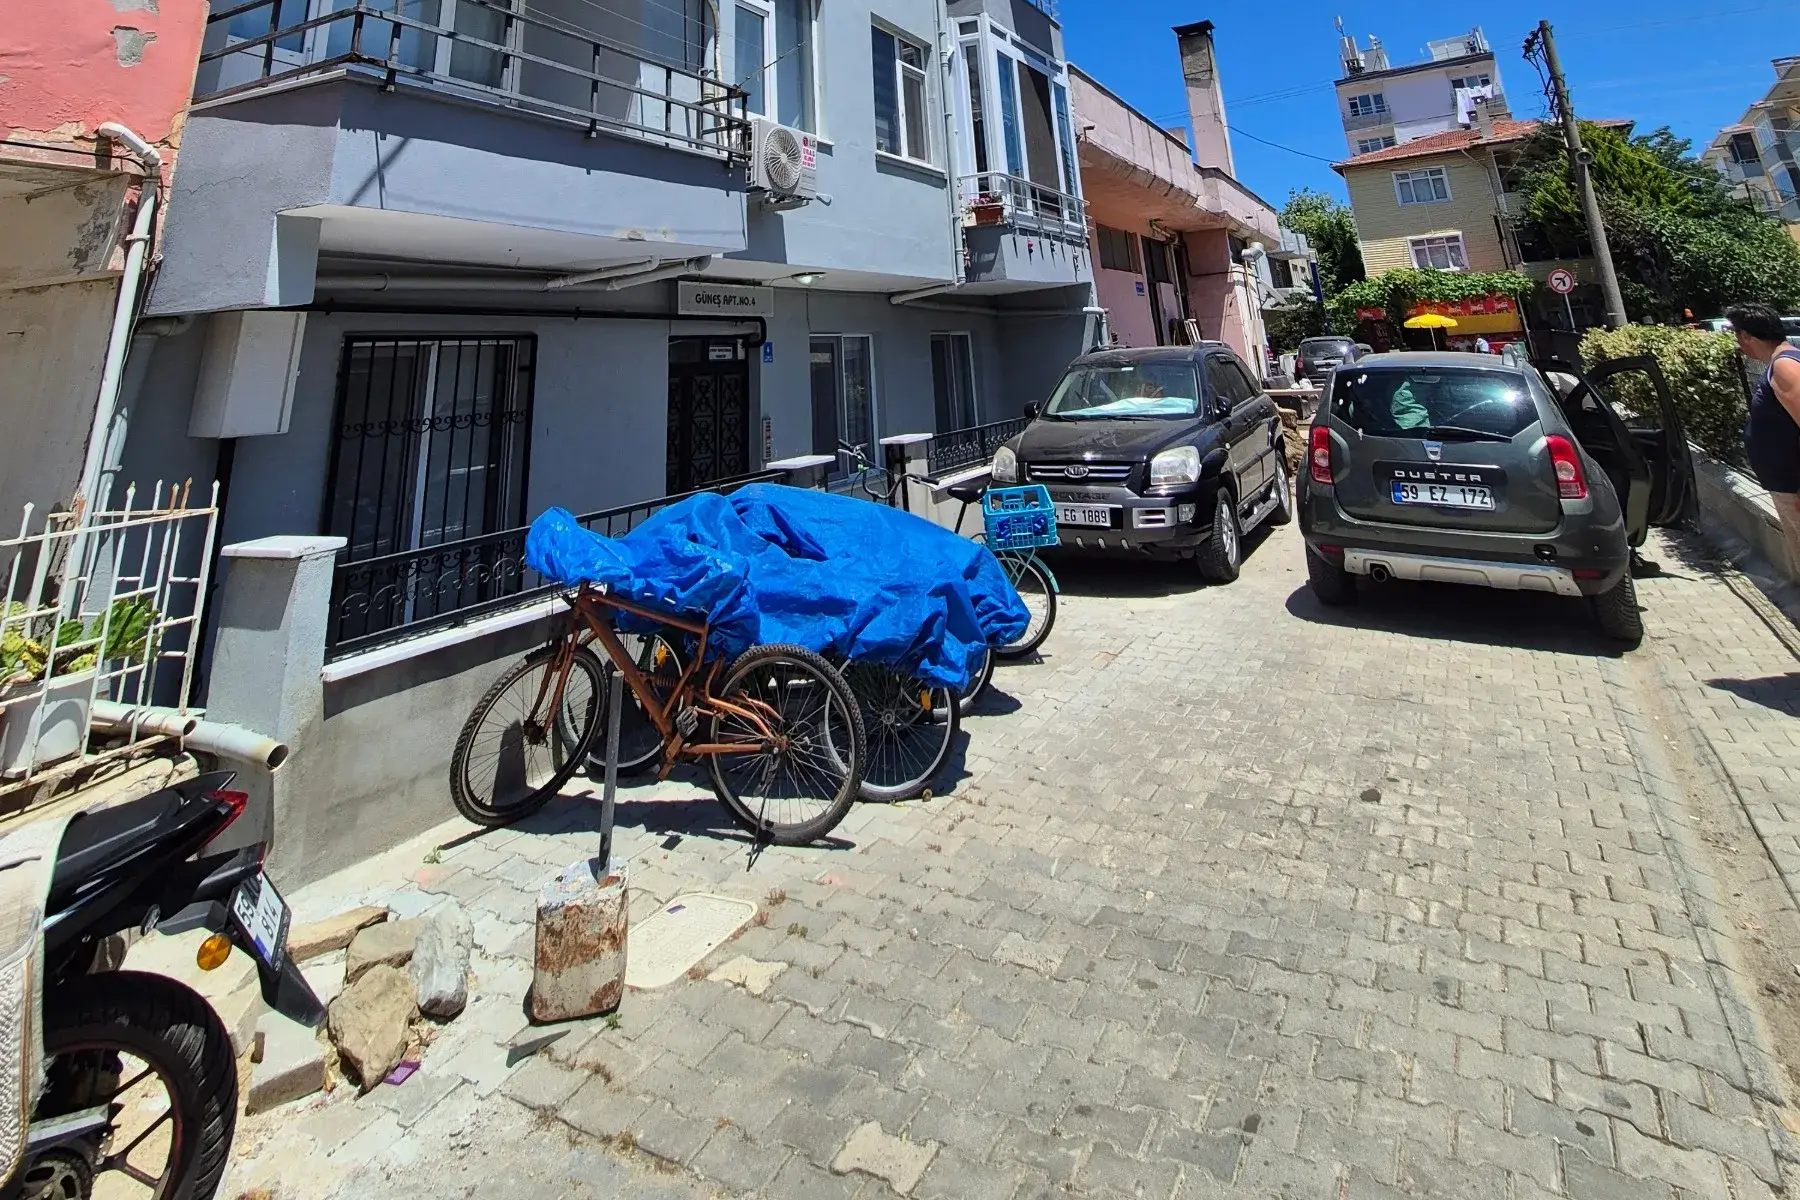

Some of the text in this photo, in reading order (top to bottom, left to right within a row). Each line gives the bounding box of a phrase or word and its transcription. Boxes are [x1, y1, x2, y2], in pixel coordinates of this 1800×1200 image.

[1395, 470, 1482, 482] DUSTER
[1401, 483, 1488, 505] 59 EZ 172
[1064, 508, 1076, 522] EG
[1082, 509, 1107, 523] 1889
[238, 894, 254, 928] 59
[261, 897, 278, 939] 814
